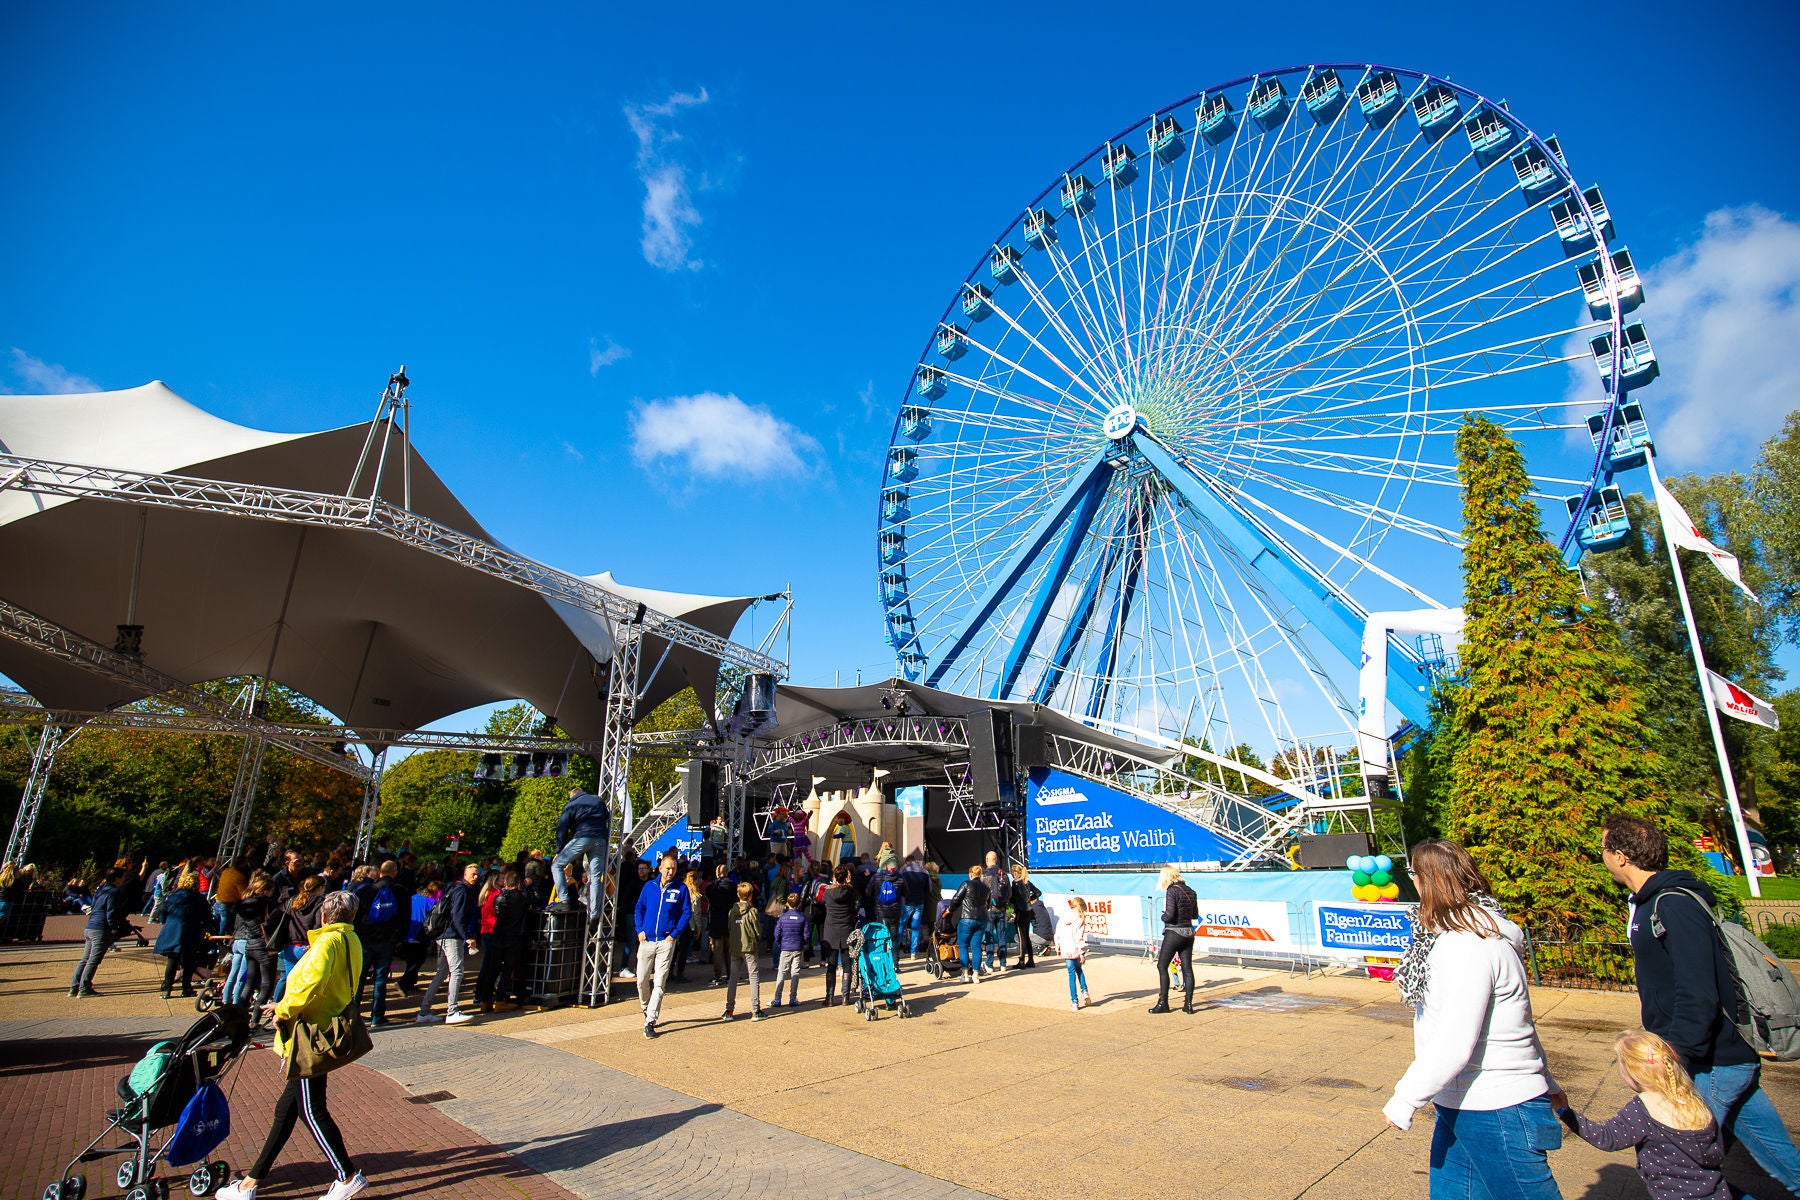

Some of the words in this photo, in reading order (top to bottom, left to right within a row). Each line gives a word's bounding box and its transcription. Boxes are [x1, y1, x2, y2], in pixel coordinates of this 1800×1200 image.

[1050, 787, 1076, 797] SIGMA
[1035, 811, 1114, 836] EigenZaak
[1036, 833, 1121, 853] Familiedag
[1121, 828, 1177, 849] Walibi
[1206, 913, 1251, 927] SIGMA
[1323, 911, 1404, 930] EigenZaak
[1206, 926, 1245, 937] EigenZaak
[1325, 928, 1411, 949] Familiedag
